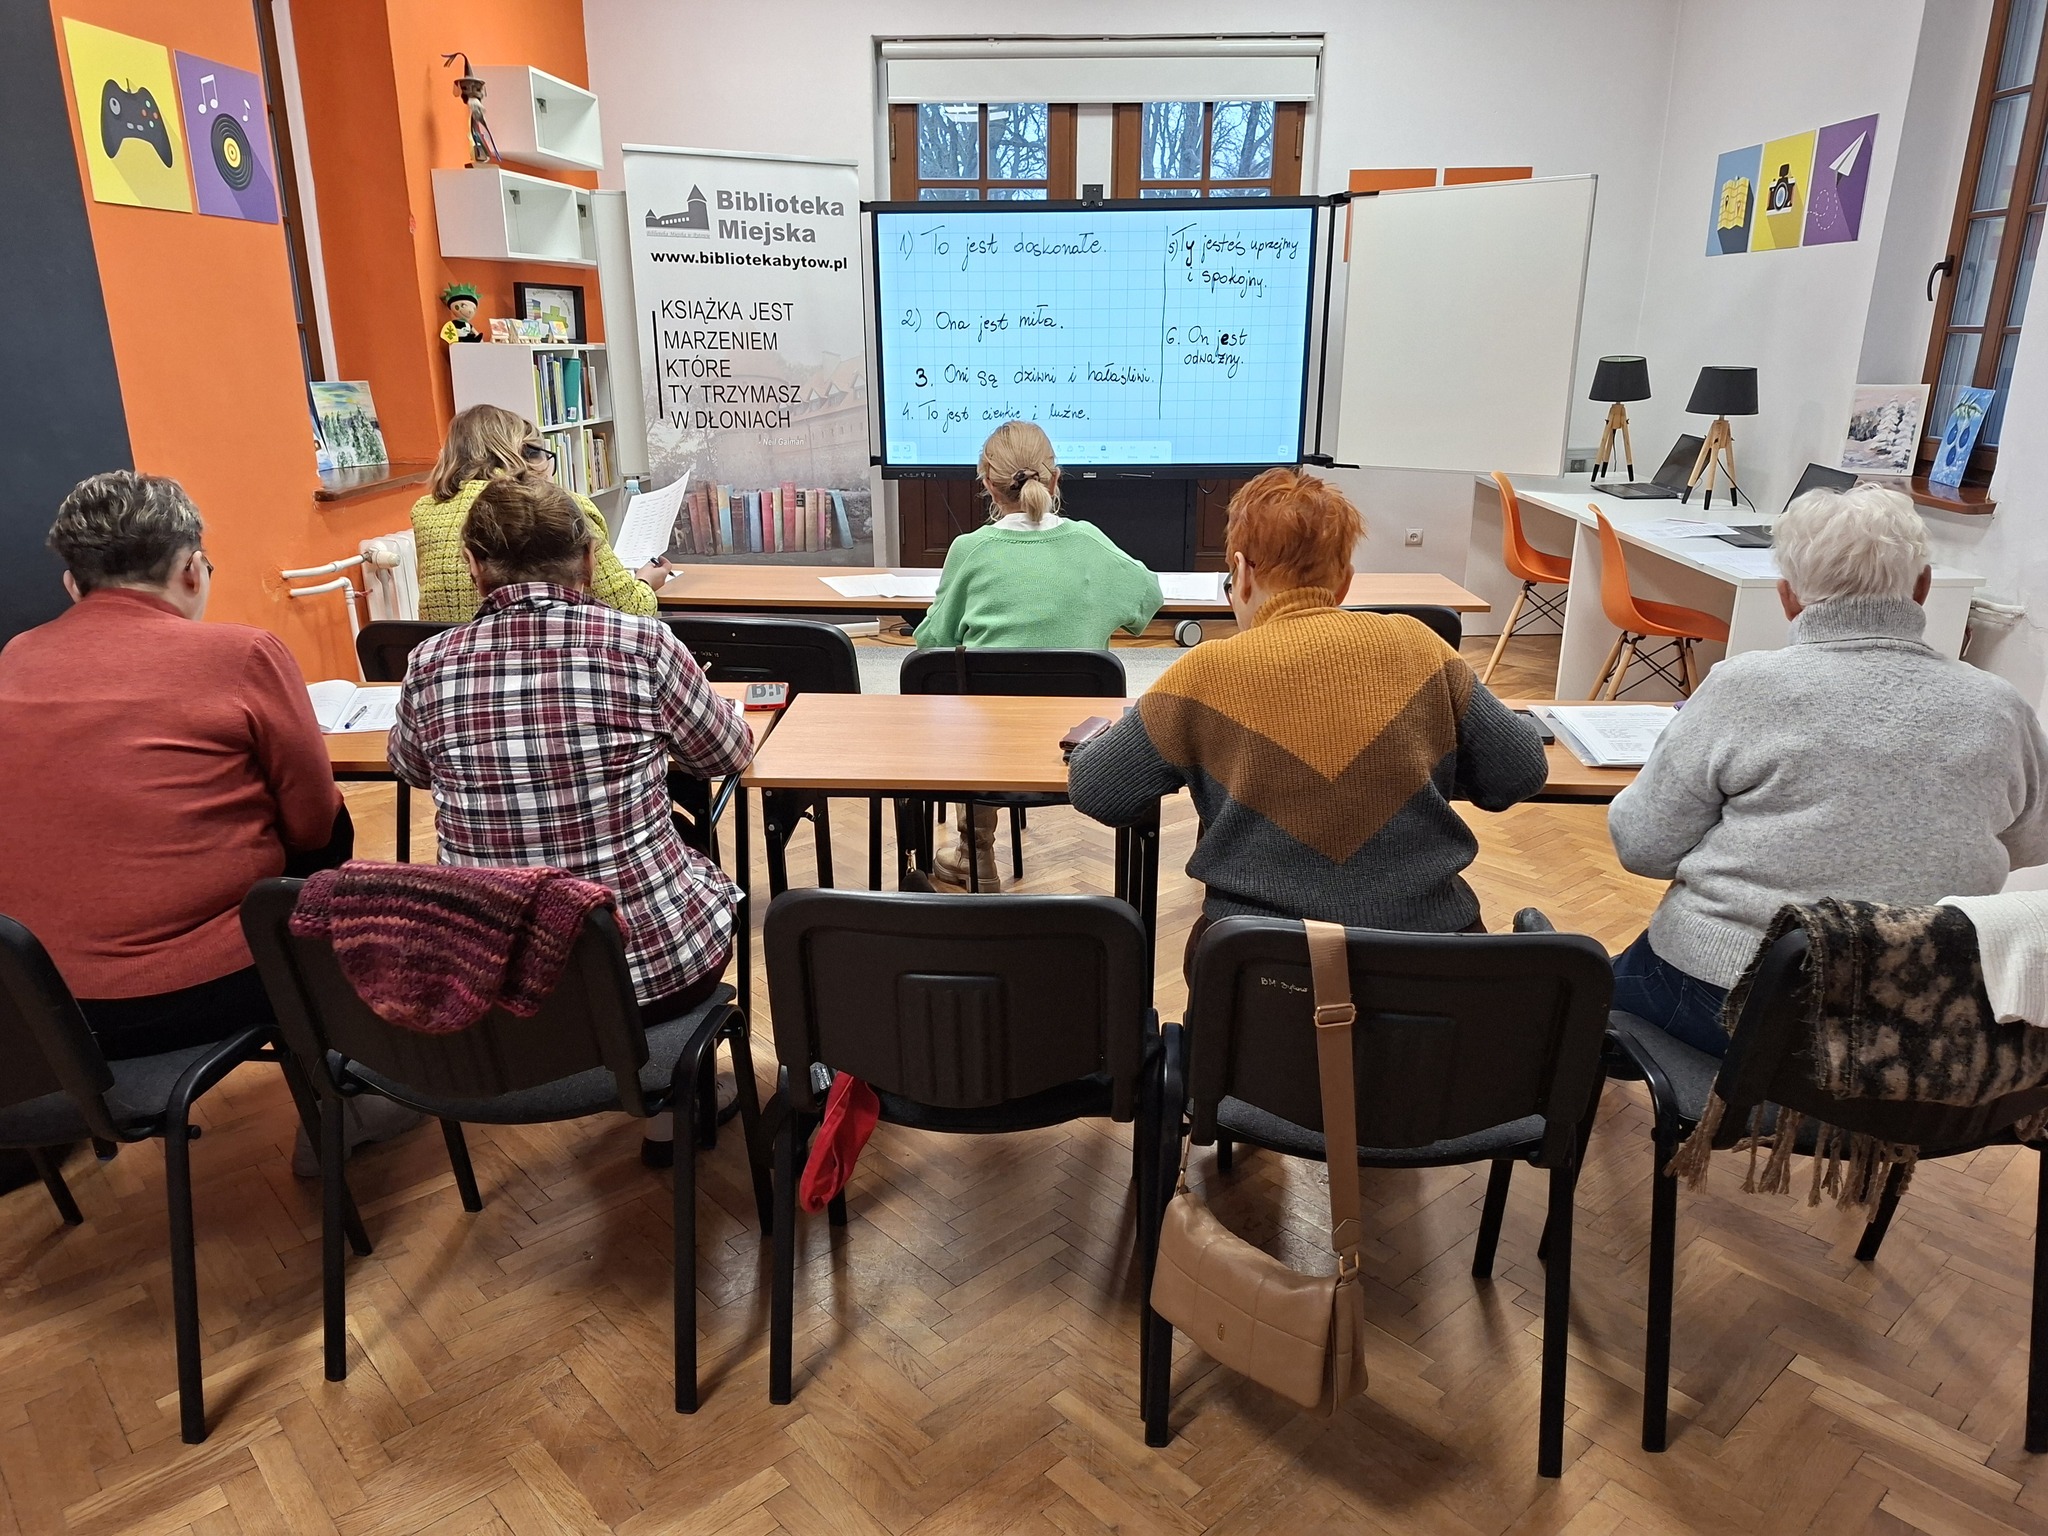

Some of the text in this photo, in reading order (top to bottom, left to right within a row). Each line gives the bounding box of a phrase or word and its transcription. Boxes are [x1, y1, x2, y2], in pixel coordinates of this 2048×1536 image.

[716, 189, 845, 217] Biblioteka
[718, 219, 817, 246] Miejska
[1171, 222, 1196, 267] Ty
[1200, 231, 1246, 264] jesteś
[1250, 237, 1299, 260] uprzejmy
[650, 251, 848, 271] www.bibliotekabytow.pl
[920, 225, 950, 255] To
[961, 232, 999, 272] jest
[1187, 265, 1267, 298] i spokojny.
[660, 296, 794, 325] KSIĄŻKA JEST
[935, 311, 971, 331] Ona
[977, 312, 1009, 343] jest
[1018, 304, 1064, 330] miła.
[663, 330, 778, 351] MARZENIEM
[1188, 325, 1210, 346] On
[1214, 327, 1248, 358] jest
[665, 354, 732, 378] KTÓRE
[914, 367, 934, 388] 3.
[943, 363, 970, 384] Oni
[976, 370, 999, 389] są
[1013, 365, 1057, 385] dziwni
[1067, 365, 1078, 383] i
[667, 384, 802, 404] TY TRZYMASZ
[670, 410, 791, 430] W DŁONIACH
[918, 398, 939, 421] To
[942, 406, 970, 434] jest
[981, 400, 1022, 421] cienkie
[1031, 404, 1038, 421] i
